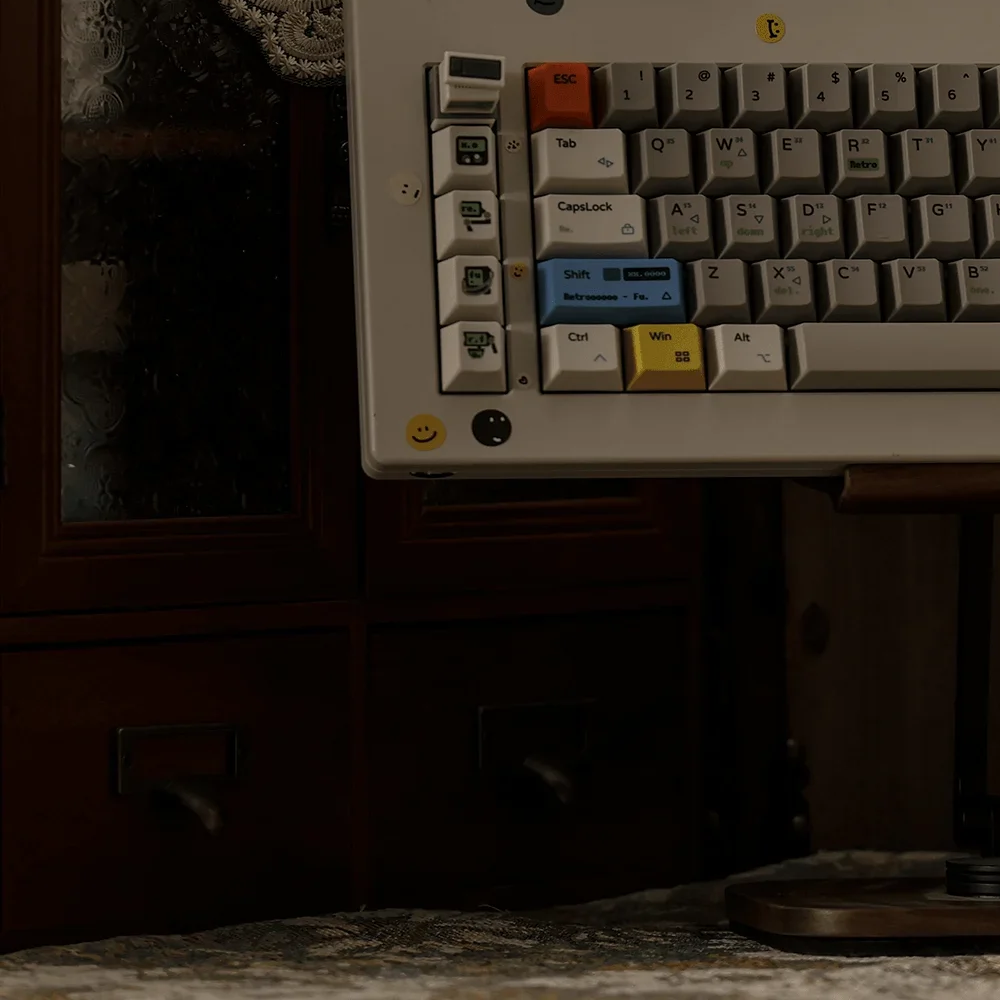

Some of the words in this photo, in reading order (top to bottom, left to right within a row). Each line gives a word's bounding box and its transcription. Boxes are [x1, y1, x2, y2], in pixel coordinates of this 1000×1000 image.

[554, 74, 577, 84] ESC
[698, 70, 711, 82] @
[767, 72, 775, 82] #
[831, 71, 840, 84] $
[895, 72, 906, 83] %
[623, 90, 630, 100] 1
[685, 90, 693, 100] 2
[752, 91, 760, 101] 3
[817, 91, 825, 101] 4
[881, 91, 889, 101] 5
[948, 90, 956, 100] 6
[556, 138, 577, 148] Tab
[651, 138, 665, 153] Q
[716, 138, 733, 150] W
[782, 138, 792, 151] E
[848, 139, 859, 152] R
[912, 138, 923, 151] T
[976, 138, 987, 151] Y
[849, 160, 878, 169] Retro
[557, 202, 613, 213] CapsLock
[671, 203, 683, 216] A
[736, 203, 747, 217] S
[803, 203, 815, 216] D
[867, 203, 876, 215] F
[932, 203, 944, 216] G
[671, 226, 699, 236] left
[736, 227, 764, 236] down
[801, 225, 835, 237] right
[563, 270, 591, 280] Shift
[708, 266, 719, 279] Z
[773, 266, 784, 279] X
[838, 267, 850, 279] C
[903, 266, 915, 278] V
[968, 266, 979, 278] B
[633, 293, 649, 301] Fu.
[568, 333, 588, 342] Ctrl
[649, 331, 672, 341] Win
[734, 333, 750, 342] Alt
